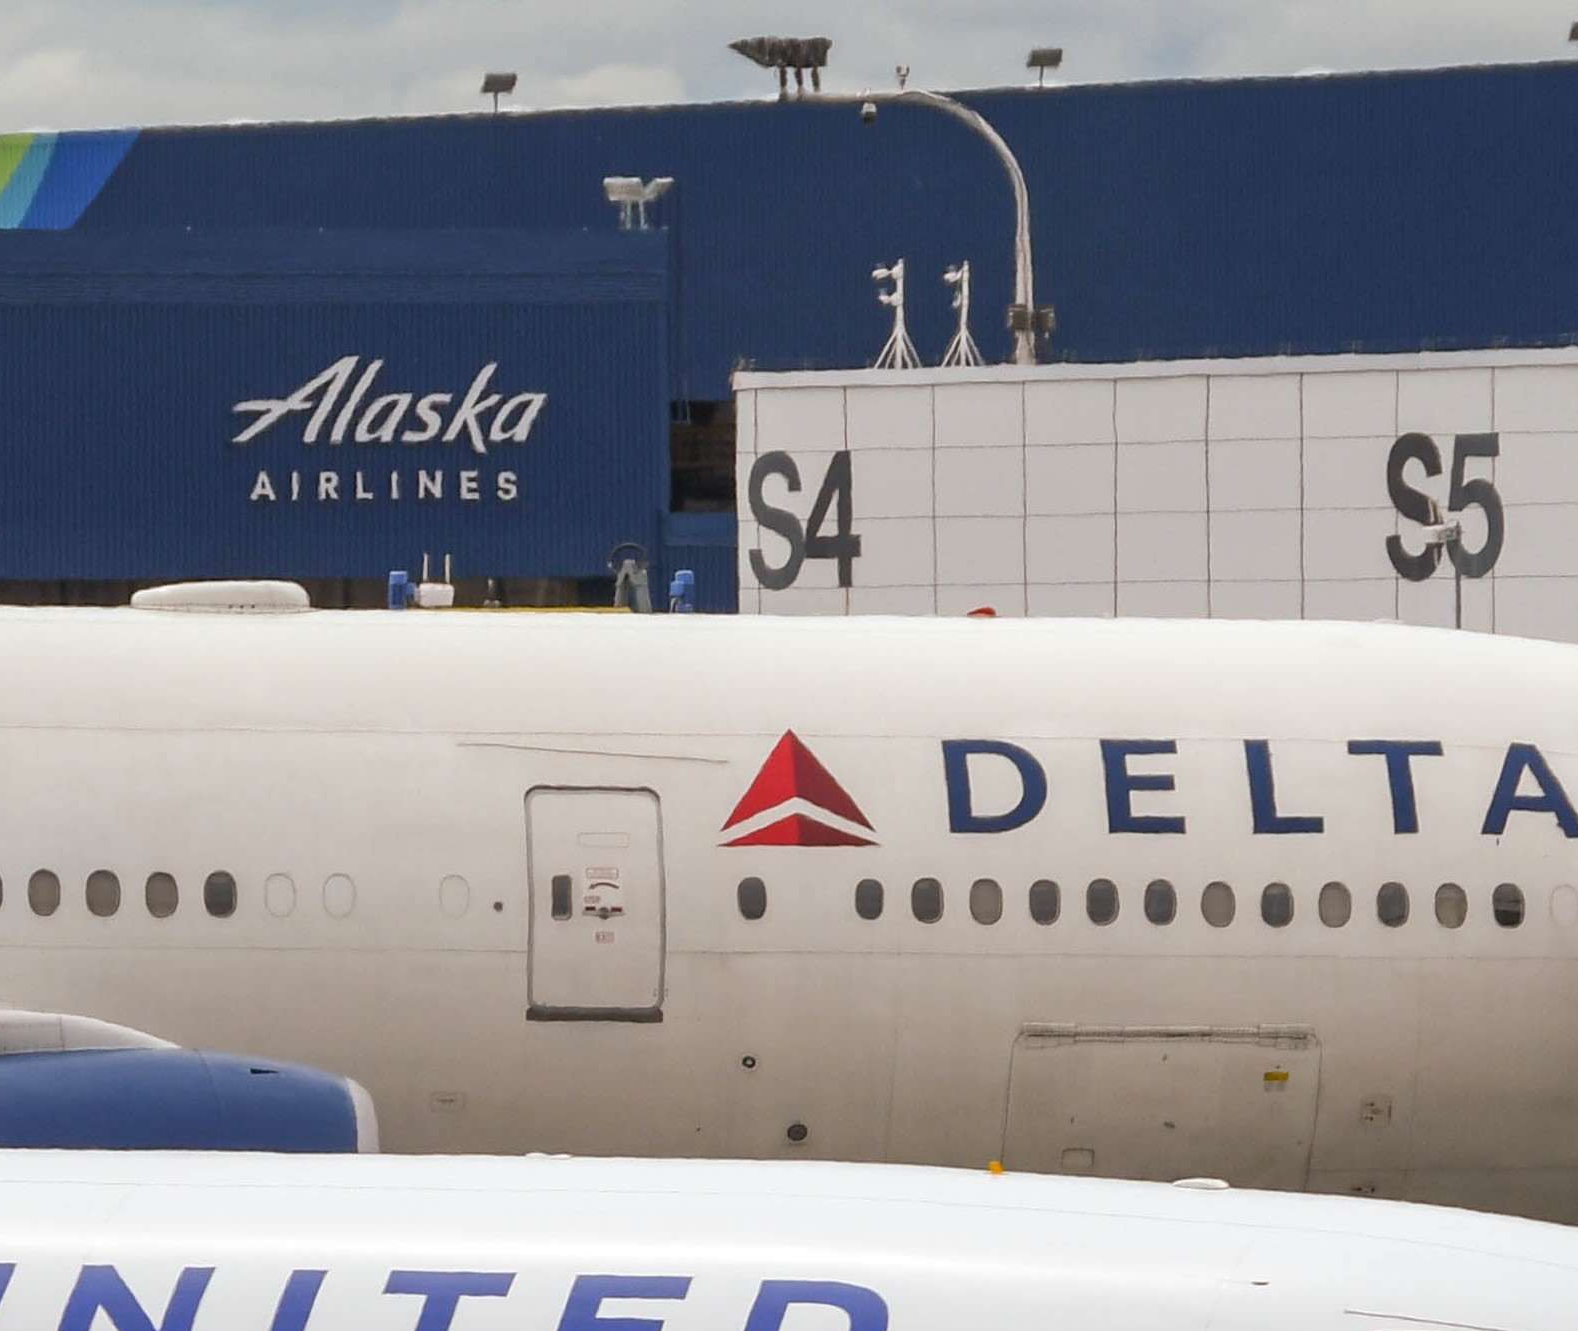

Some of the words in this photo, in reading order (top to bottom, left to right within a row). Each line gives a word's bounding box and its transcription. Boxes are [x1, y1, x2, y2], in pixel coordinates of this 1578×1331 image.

[231, 355, 547, 454] Alaska
[250, 470, 520, 502] AIRLINES
[748, 450, 861, 590] S4
[1386, 432, 1504, 582] S5
